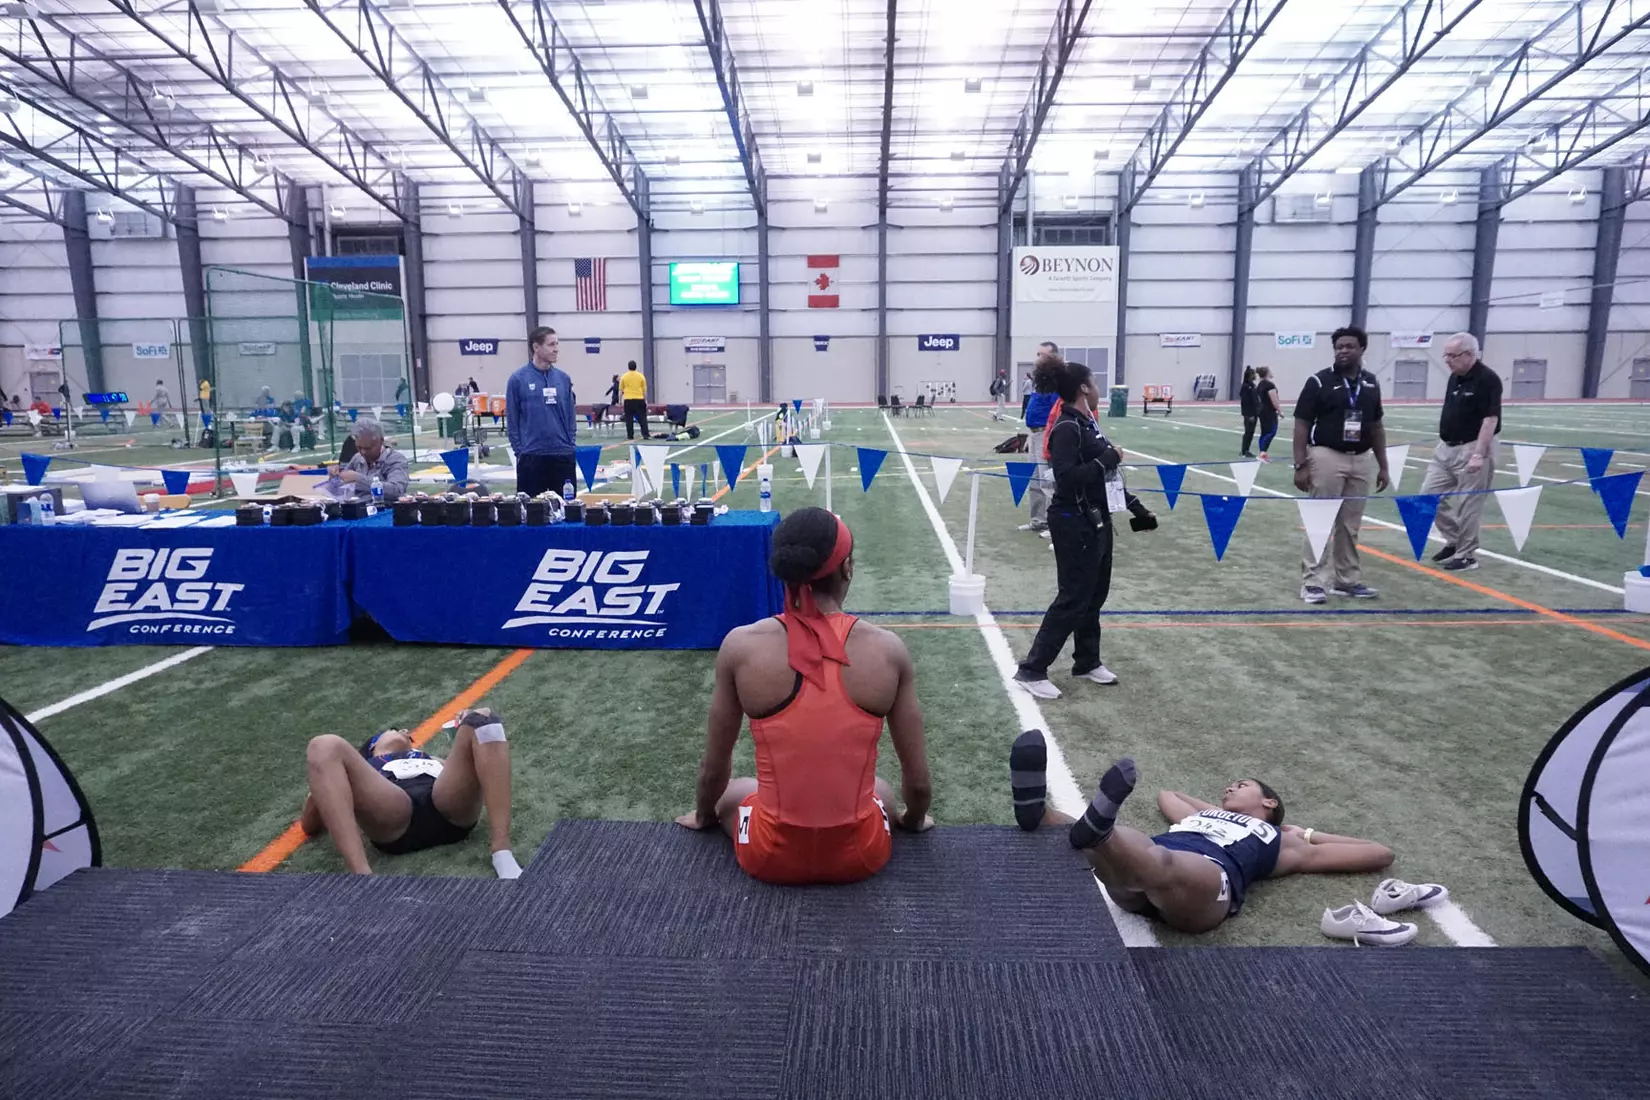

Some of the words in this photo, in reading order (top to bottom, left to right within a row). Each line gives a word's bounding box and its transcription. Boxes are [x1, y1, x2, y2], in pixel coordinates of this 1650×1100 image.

[1041, 257, 1114, 273] BEYNON
[330, 281, 369, 292] Cleveland
[370, 281, 393, 290] Clinic
[924, 336, 954, 349] Jeep
[1277, 334, 1301, 345] SoFi
[136, 345, 157, 357] SoFi
[465, 341, 493, 353] Jeep
[107, 548, 214, 581] BIG
[532, 548, 650, 584] BIG
[93, 582, 245, 613] EAST
[514, 582, 681, 616] EAST
[129, 623, 236, 635] CONFERENCE
[548, 627, 667, 640] CONFERENCE
[1253, 821, 1274, 839] 5
